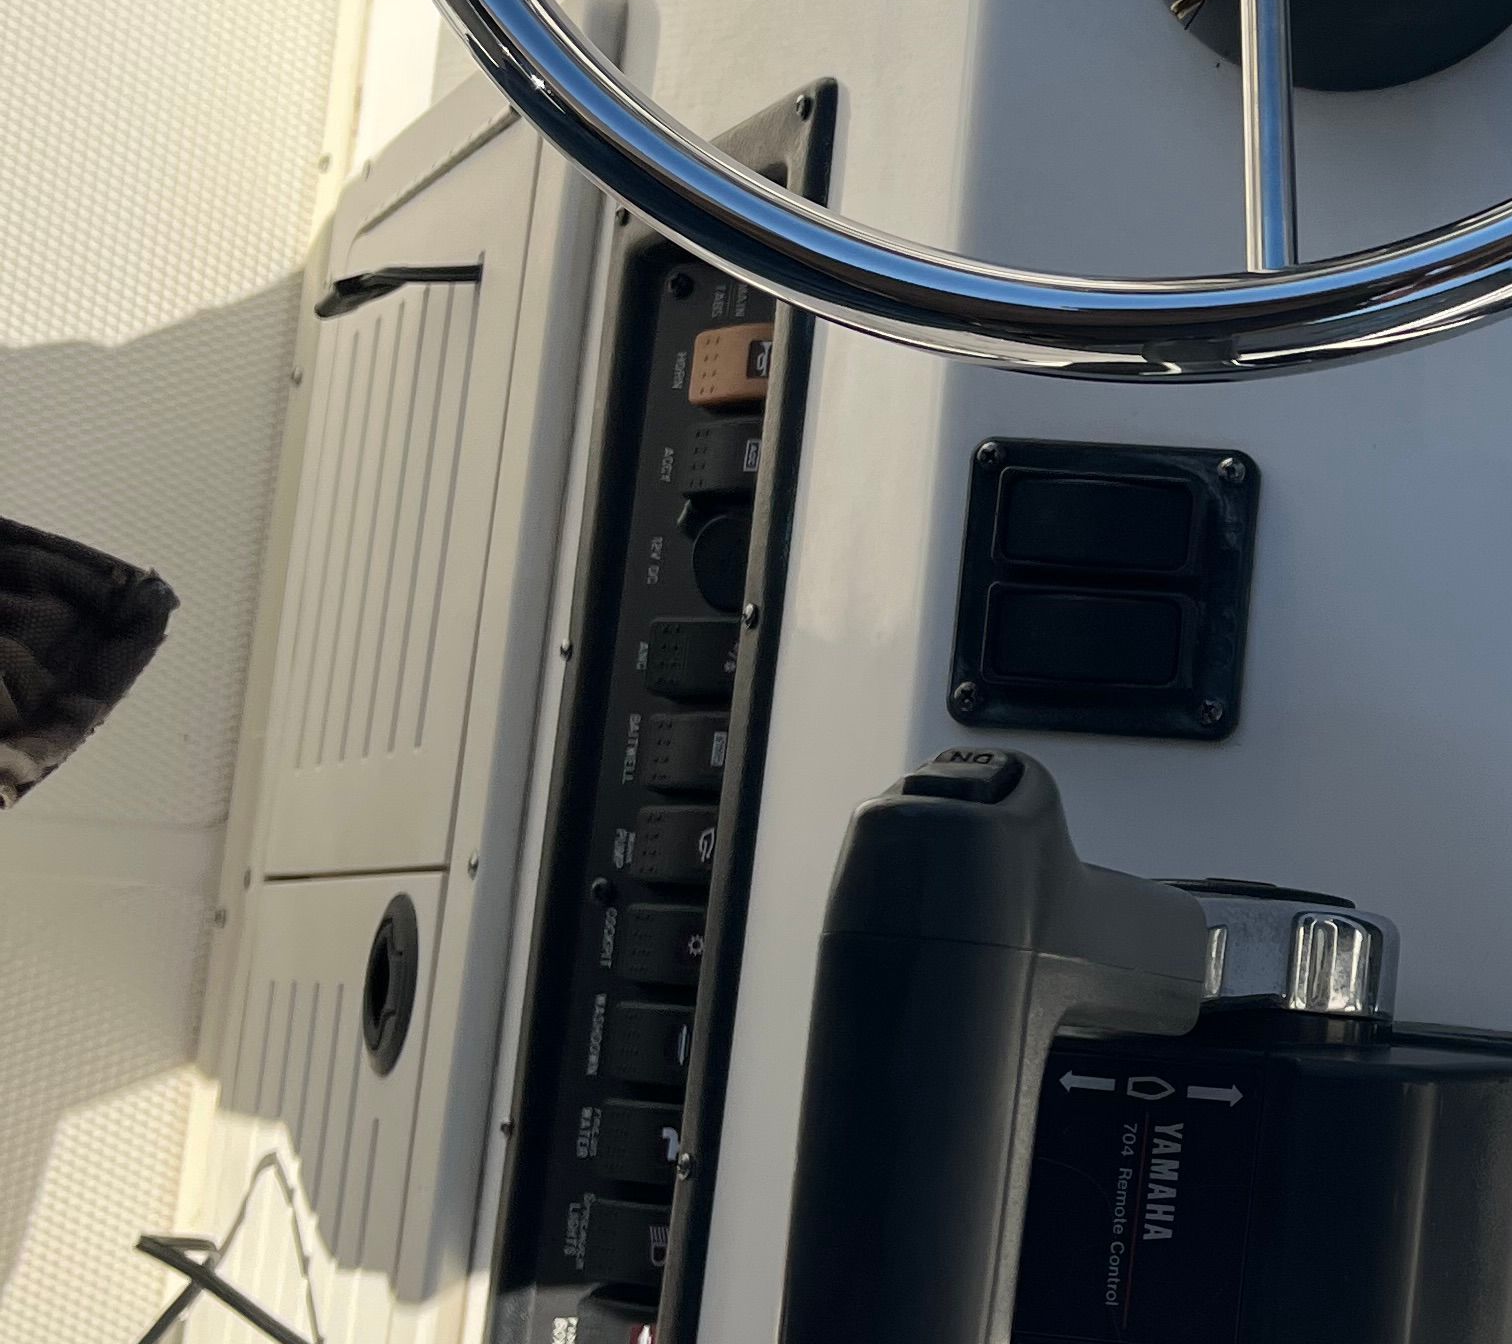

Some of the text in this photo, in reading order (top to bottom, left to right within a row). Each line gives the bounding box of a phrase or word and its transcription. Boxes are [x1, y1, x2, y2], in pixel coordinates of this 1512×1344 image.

[621, 713, 641, 784] BAITWELL
[585, 993, 608, 1076] WASHDOWN
[576, 1107, 593, 1159] WATER
[1104, 1122, 1138, 1307] 704 Remote Control
[1142, 1122, 1185, 1241] YAMAHA
